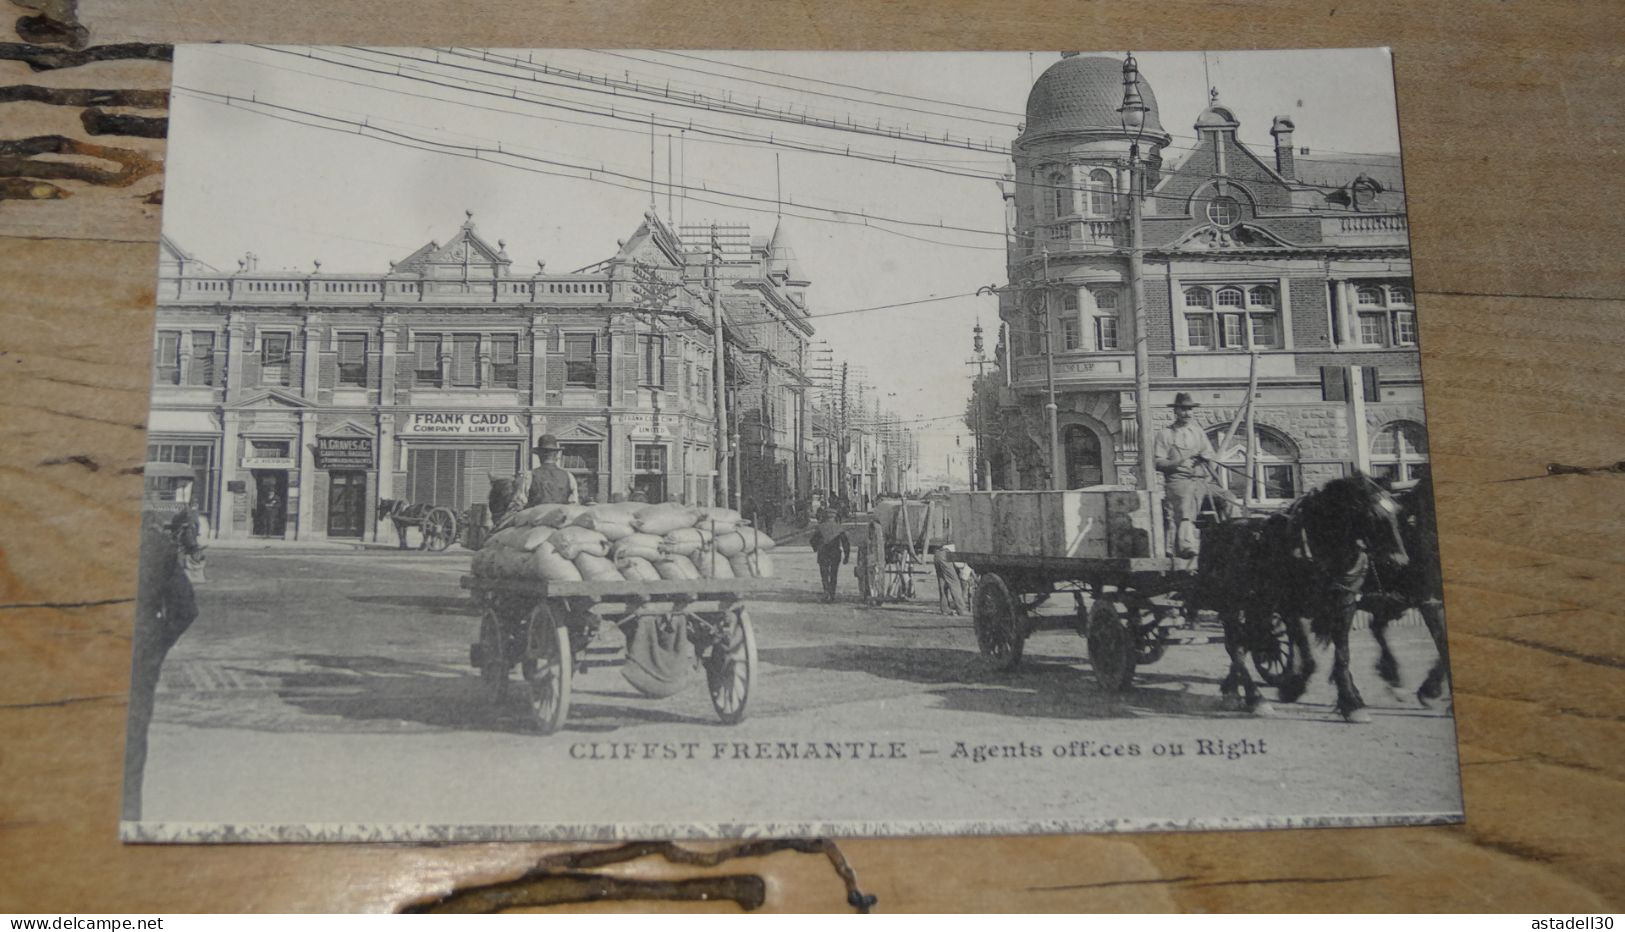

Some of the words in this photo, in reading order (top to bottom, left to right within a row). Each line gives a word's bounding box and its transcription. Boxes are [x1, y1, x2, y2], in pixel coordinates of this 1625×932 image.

[415, 413, 464, 424] FRANK
[470, 413, 509, 425] CADD
[413, 425, 461, 433] COMPANY
[569, 741, 700, 760] CLIFFST
[711, 741, 908, 760] FREMANTLE
[949, 741, 1044, 763] Agents
[1195, 737, 1269, 760] Right
